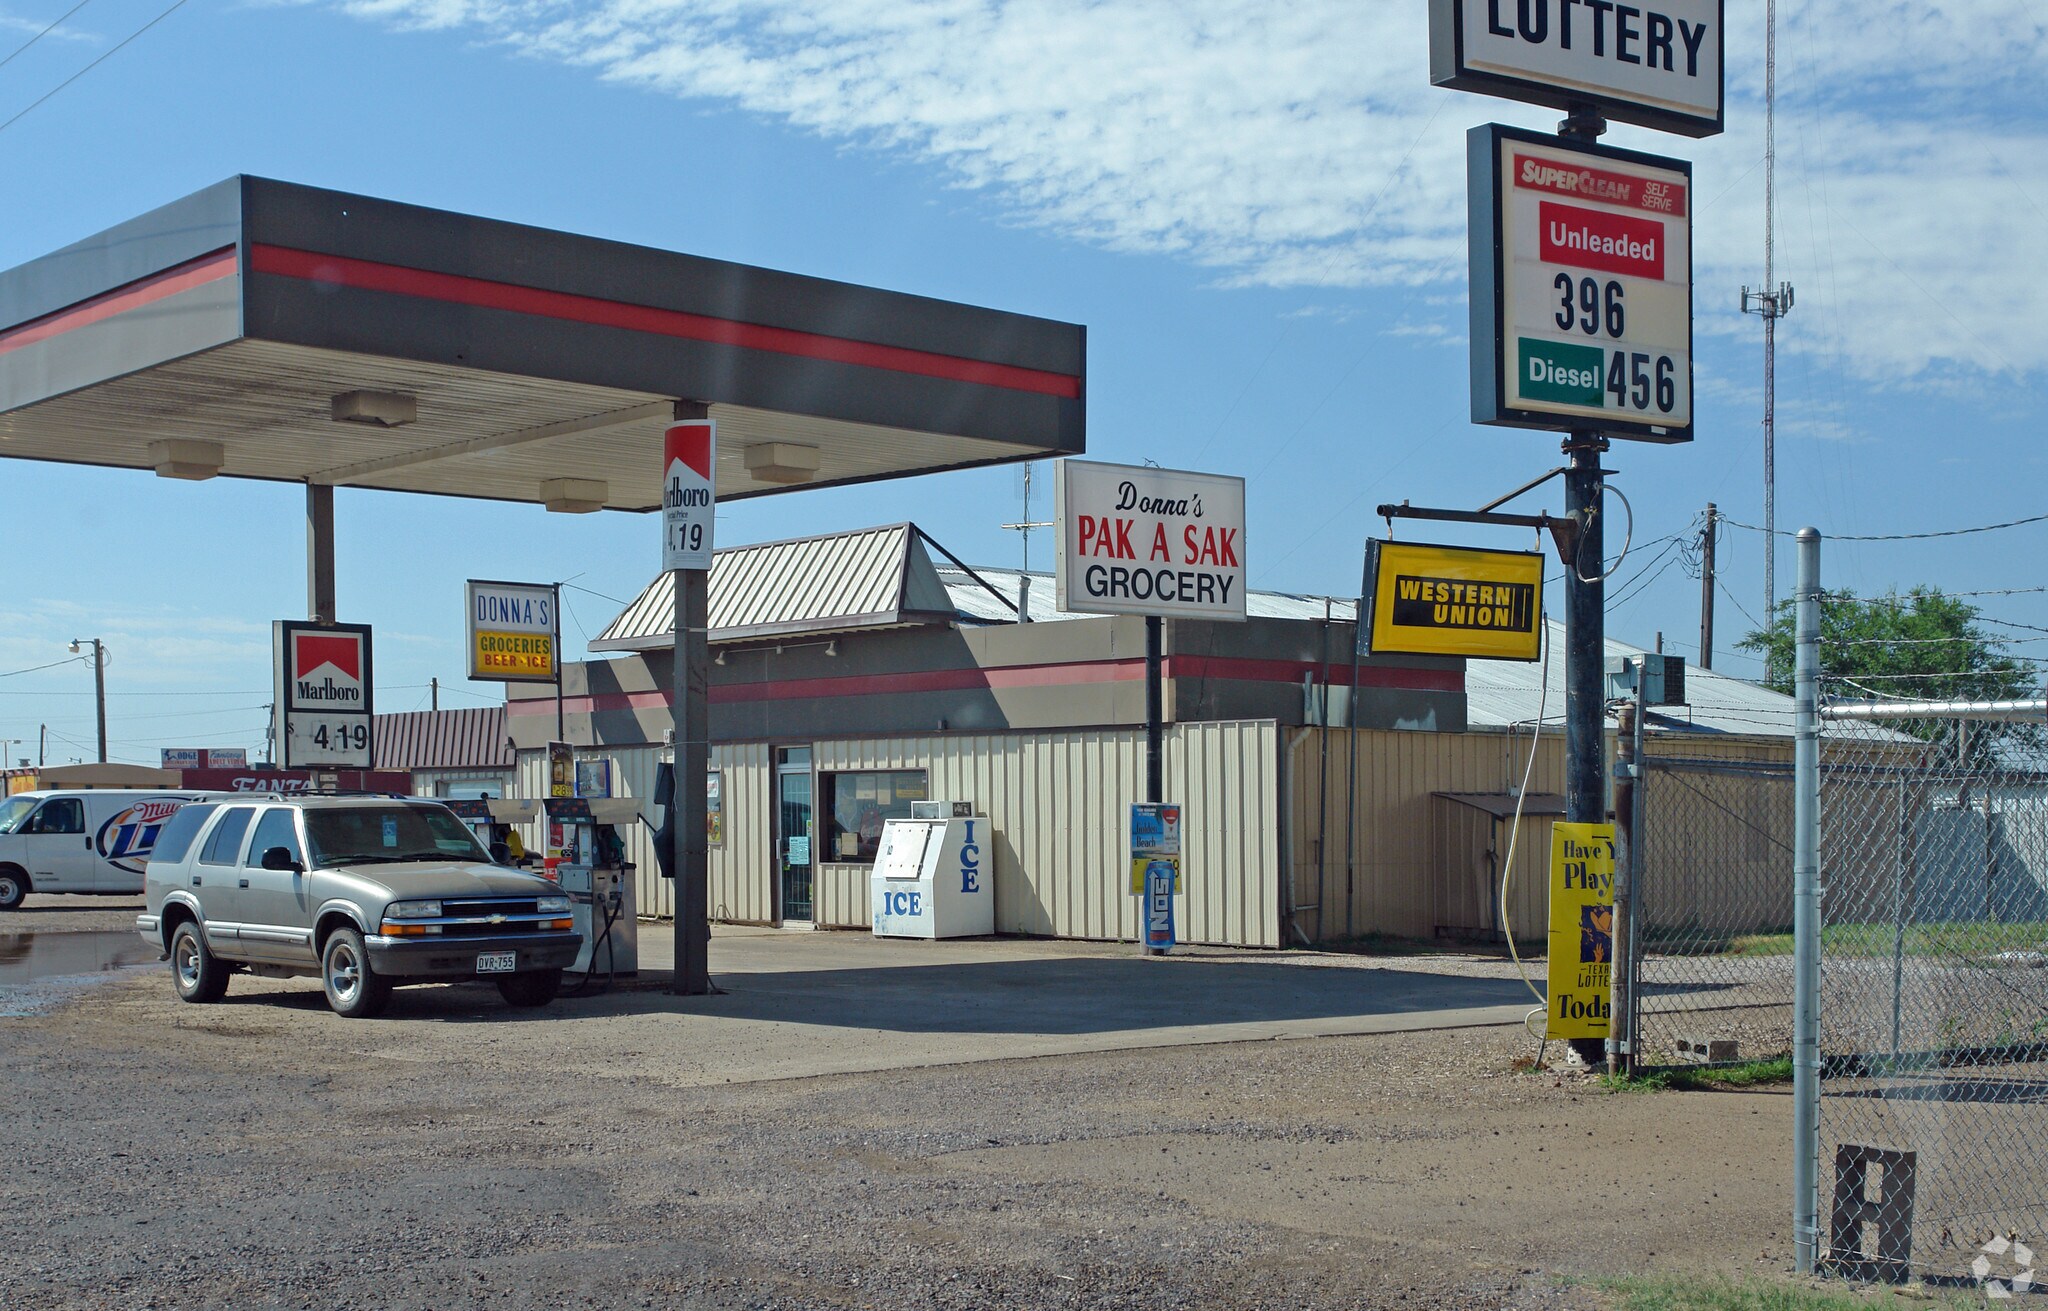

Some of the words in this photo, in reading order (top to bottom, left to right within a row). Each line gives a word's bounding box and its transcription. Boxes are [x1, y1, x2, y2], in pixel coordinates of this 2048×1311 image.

[1488, 0, 1707, 77] LOTTERY
[1645, 181, 1670, 197] SELF
[1641, 194, 1673, 212] SERVE
[1550, 221, 1655, 261] Unleaded
[1554, 272, 1625, 339] 396
[1529, 357, 1599, 389] Diesel
[1607, 351, 1675, 413] 456
[1115, 481, 1205, 518] Donna's
[1078, 515, 1136, 560] PAK
[1150, 522, 1171, 562] A
[1184, 524, 1239, 567] SAK
[1085, 564, 1234, 604] GROCERY
[1400, 579, 1510, 606] WESTERN
[478, 595, 548, 625] DONNA'S
[1433, 604, 1509, 627] UNION
[480, 636, 550, 654] GROCERIES
[484, 654, 517, 666] BEER
[527, 656, 547, 668] ICE
[297, 677, 359, 701] Marlboro
[1136, 836, 1156, 848] Beach
[1563, 840, 1602, 859] Have
[960, 820, 979, 893] ICE
[1562, 862, 1615, 897] Play
[884, 891, 922, 916] ICE
[1578, 973, 1609, 988] LOTTE
[1588, 964, 1611, 975] TEXA
[1558, 994, 1611, 1020] Toda
